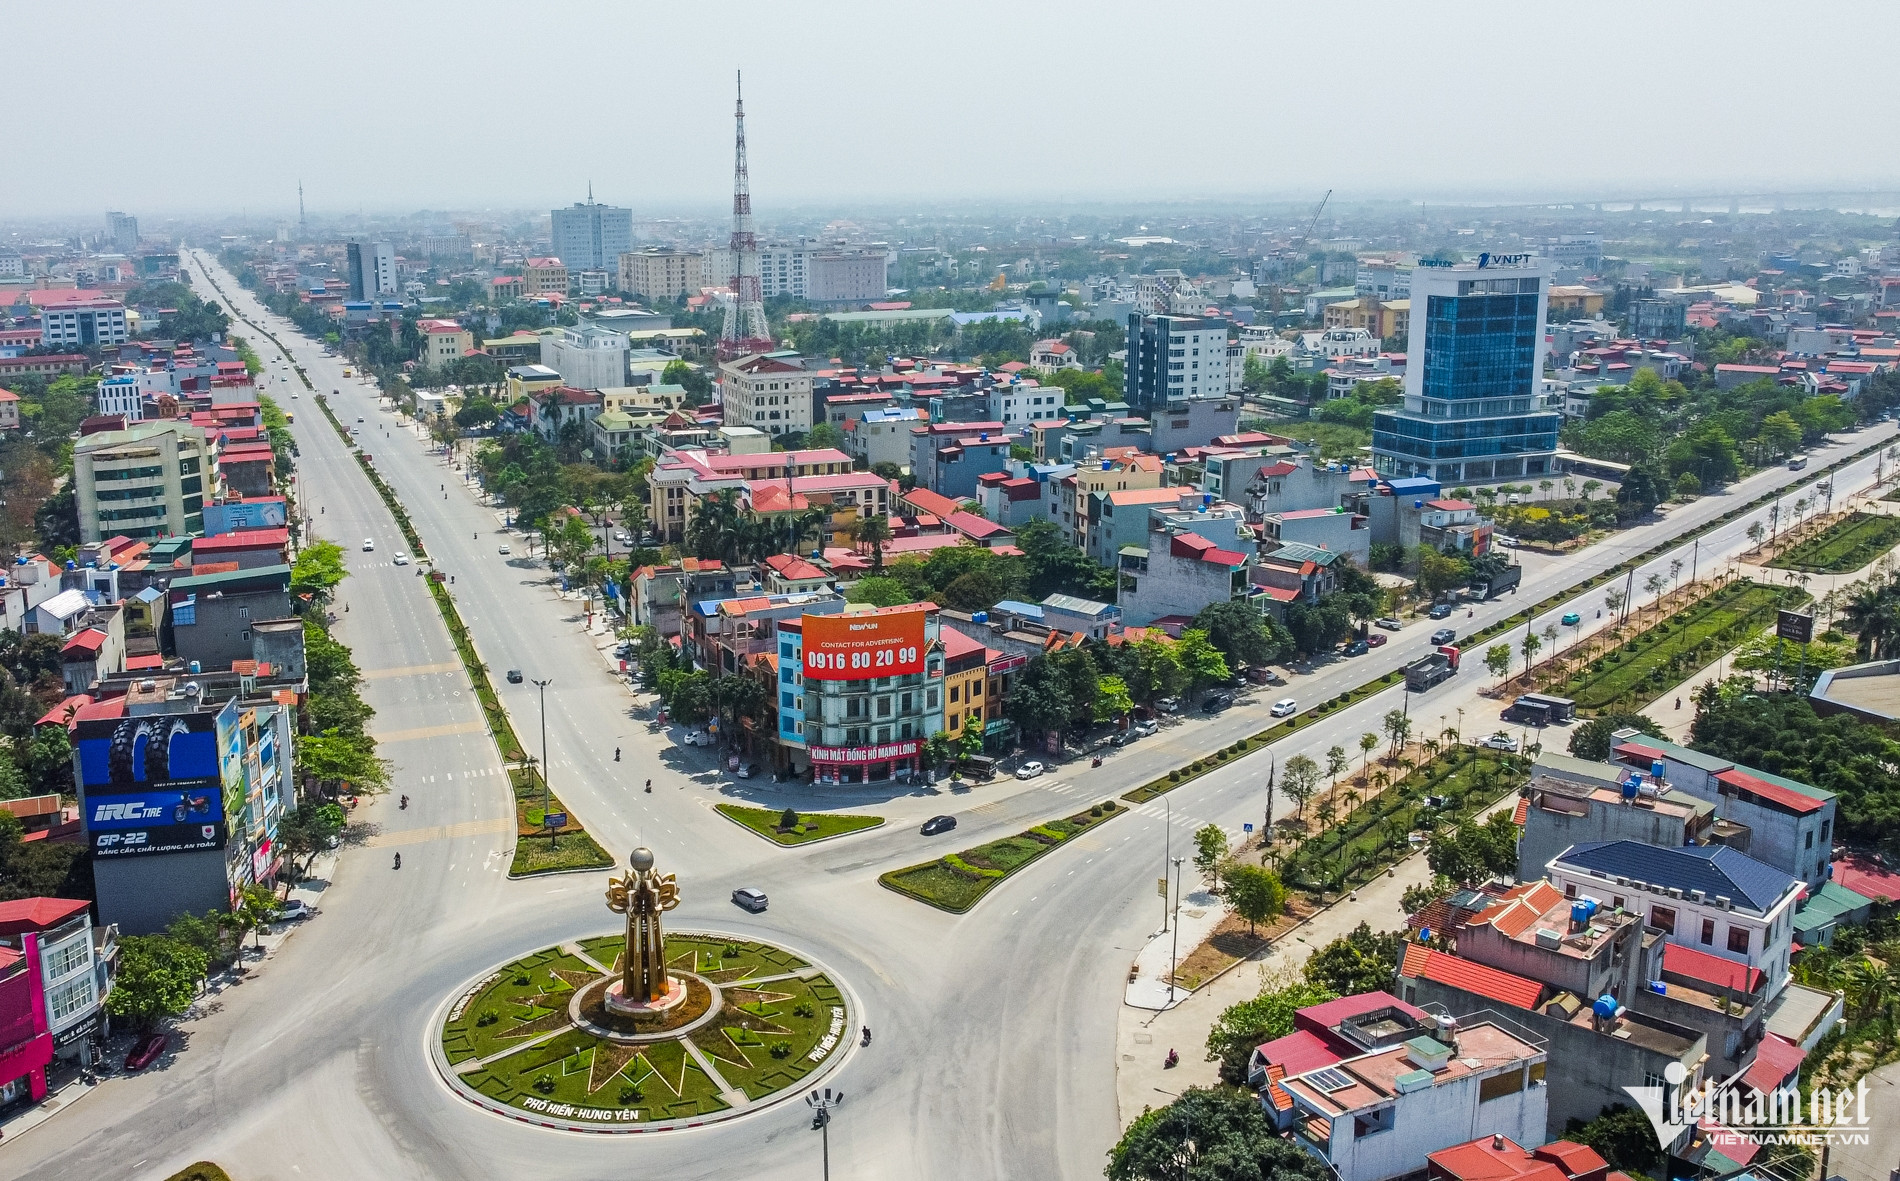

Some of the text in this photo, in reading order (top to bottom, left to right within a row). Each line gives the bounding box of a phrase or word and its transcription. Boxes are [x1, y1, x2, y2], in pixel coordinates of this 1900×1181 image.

[1492, 254, 1531, 264] VNPT
[865, 637, 904, 647] ADVERTISING
[808, 646, 917, 670] 0916 80 20 99
[811, 747, 829, 760] KÍNH
[878, 746, 898, 759] MẠNH
[899, 742, 917, 755] LONG
[142, 807, 162, 818] TIRE
[97, 832, 147, 846] GP-22
[196, 841, 217, 849] TOÀN
[808, 1045, 827, 1062] PHỐ
[523, 1097, 550, 1110] PHỐ
[615, 1108, 639, 1120] YÊN
